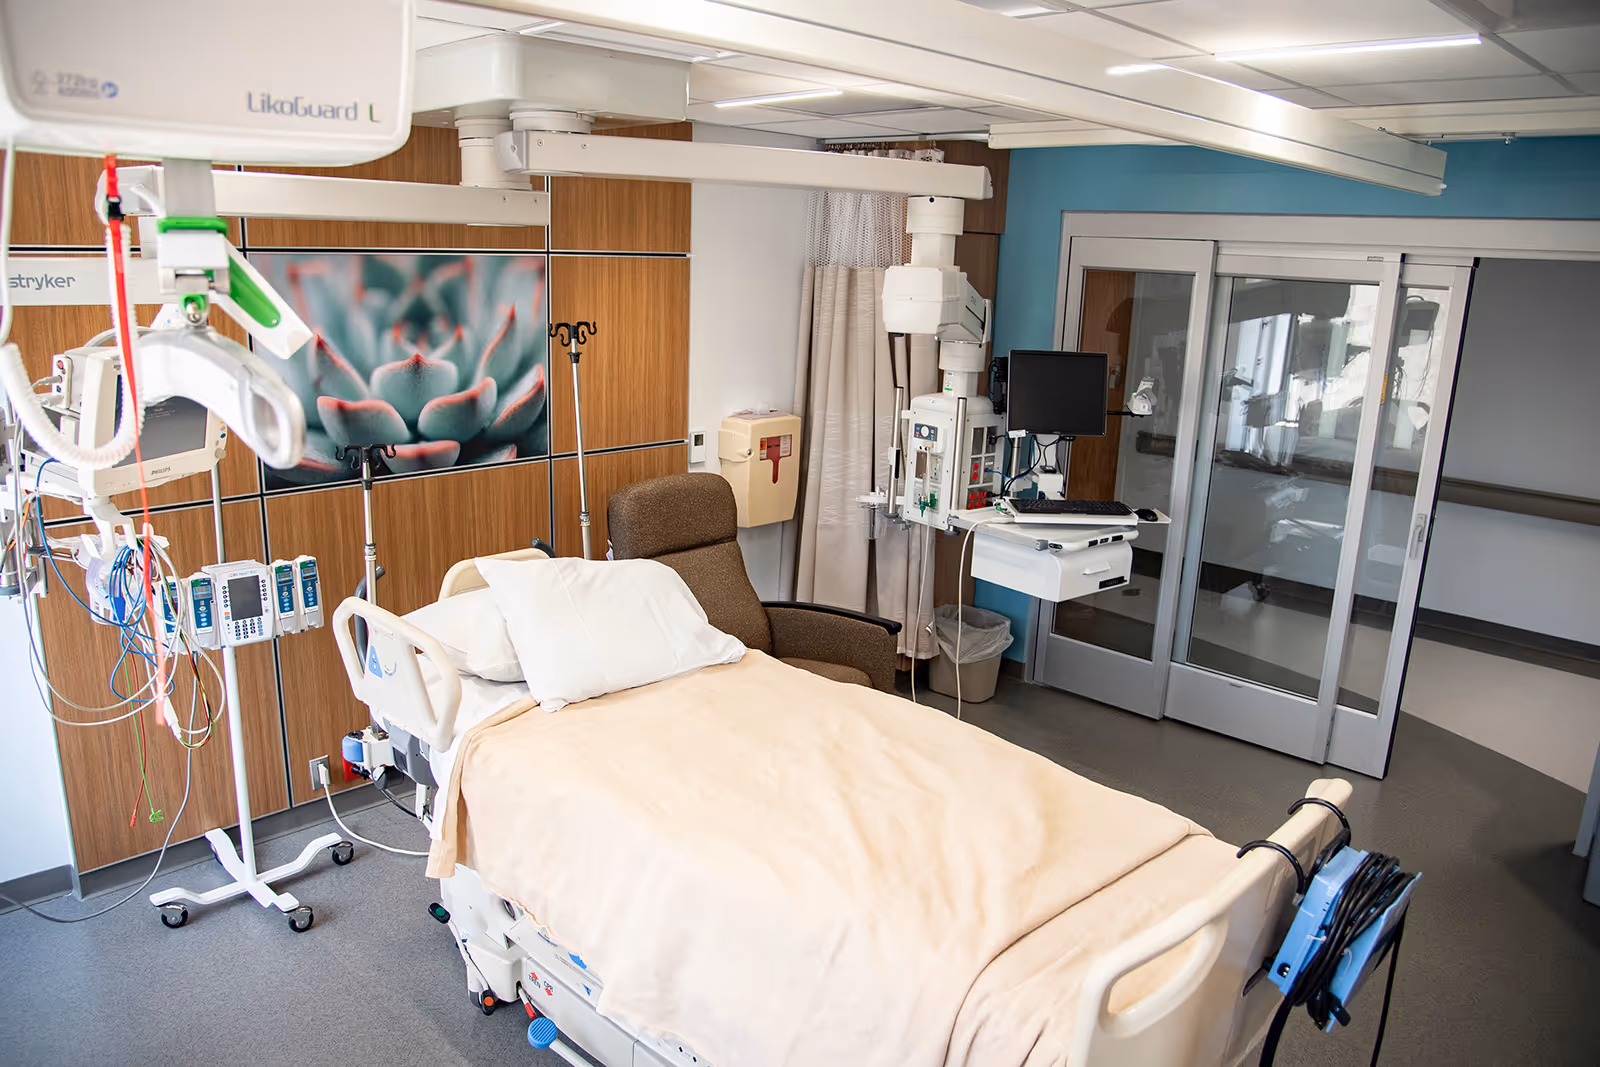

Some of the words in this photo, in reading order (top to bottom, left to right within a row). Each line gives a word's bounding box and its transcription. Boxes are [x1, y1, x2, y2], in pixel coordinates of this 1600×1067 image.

[247, 91, 358, 121] LikoGuard
[368, 102, 382, 123] L
[8, 273, 76, 290] stryker
[151, 466, 171, 475] PHILIPS
